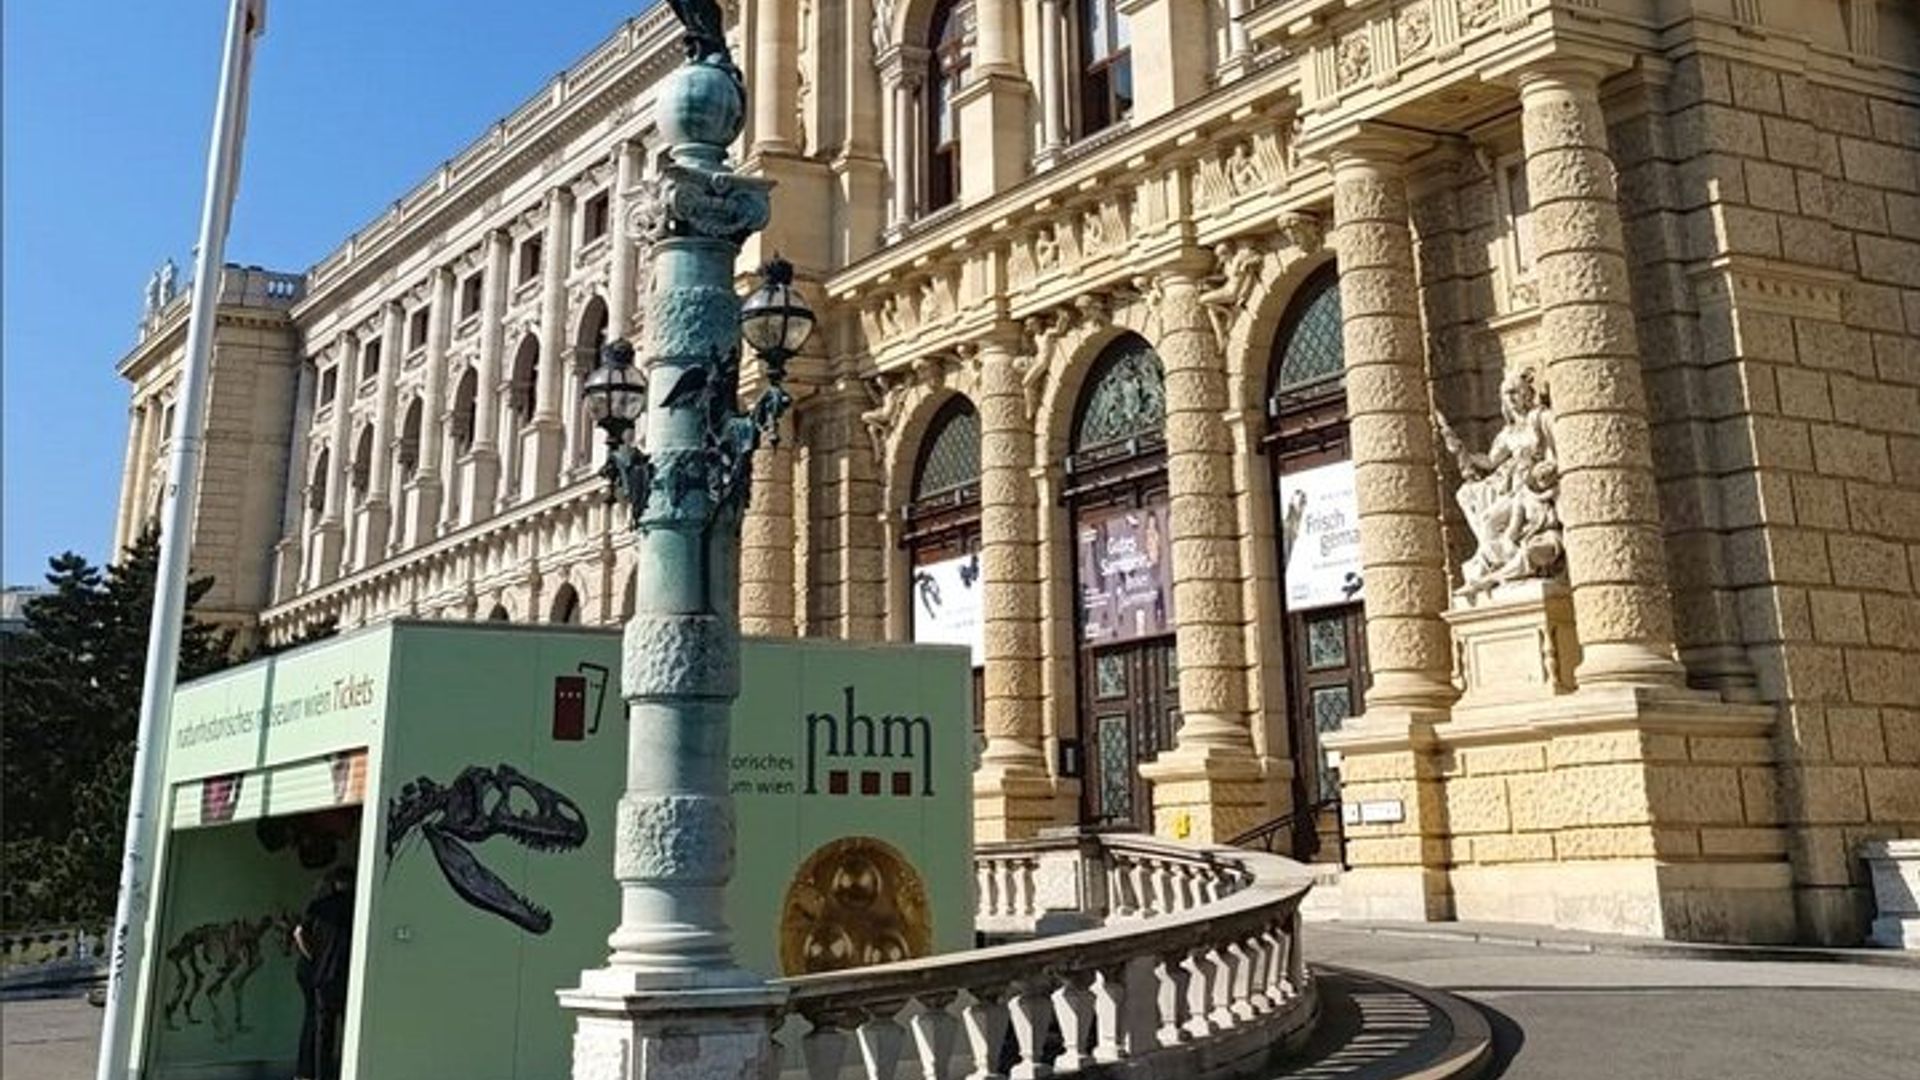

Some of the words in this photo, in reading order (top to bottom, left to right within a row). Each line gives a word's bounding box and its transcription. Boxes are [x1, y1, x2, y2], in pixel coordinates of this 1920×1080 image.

[332, 673, 375, 712] Tickets
[803, 686, 935, 796] nhm
[728, 753, 794, 770] orisches
[757, 778, 795, 794] wien
